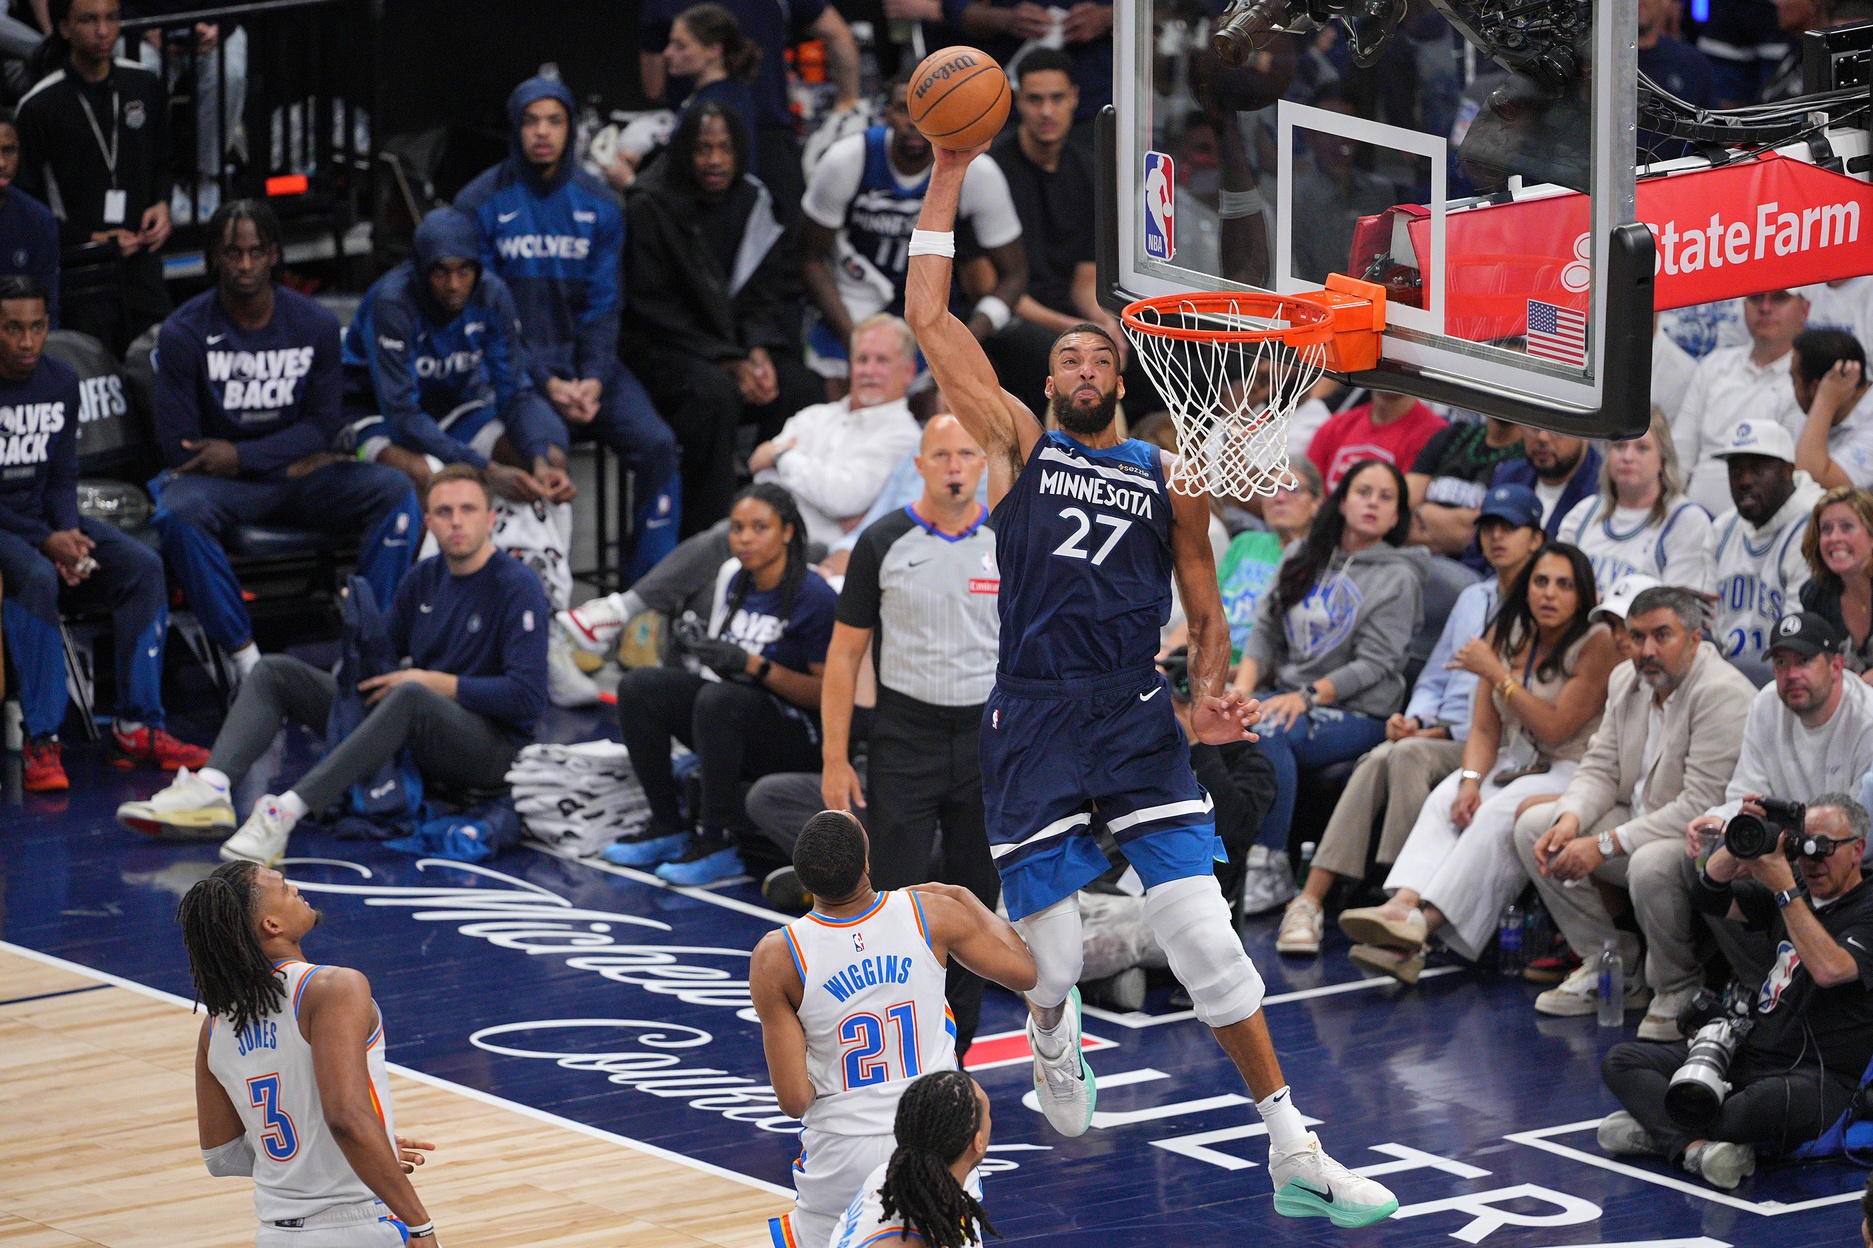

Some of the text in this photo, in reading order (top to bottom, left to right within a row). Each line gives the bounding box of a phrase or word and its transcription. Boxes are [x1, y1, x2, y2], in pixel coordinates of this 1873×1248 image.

[914, 54, 979, 99] Wilson
[1148, 233, 1163, 253] NBA
[206, 346, 315, 382] WOLVES
[223, 378, 298, 411] BACK
[1039, 469, 1153, 520] MINNESOTA
[1051, 507, 1133, 566] 27
[822, 954, 913, 1003] WIGGINS
[237, 1018, 277, 1057] JONES
[837, 999, 923, 1092] 21
[245, 1071, 300, 1163] 3
